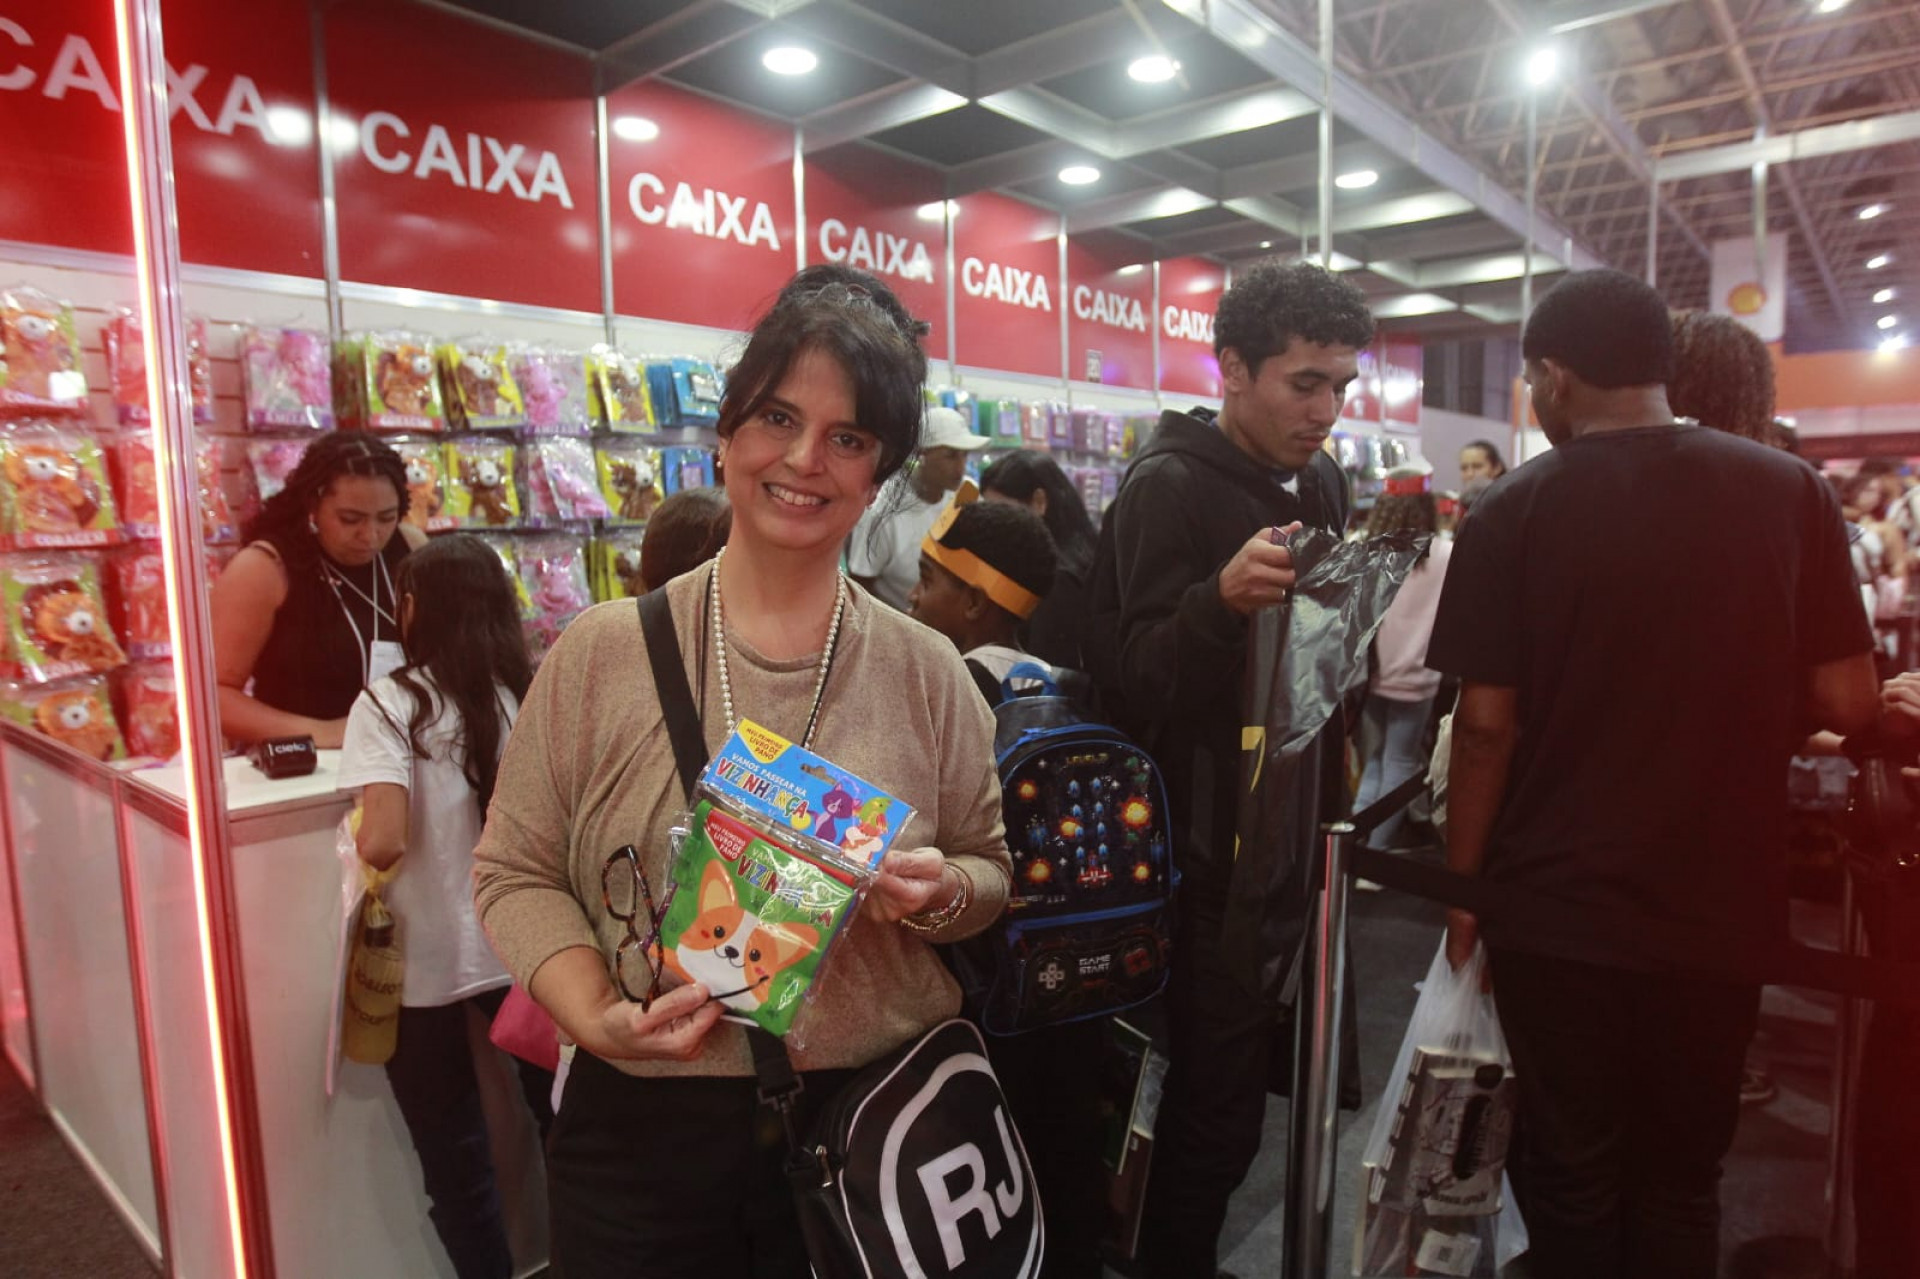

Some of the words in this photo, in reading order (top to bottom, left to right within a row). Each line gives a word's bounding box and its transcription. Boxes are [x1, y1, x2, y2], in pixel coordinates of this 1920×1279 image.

[0, 17, 280, 146] CAXA
[359, 110, 574, 210] CAIXA
[628, 172, 780, 251] CAIXA
[819, 218, 934, 284] CAIXA
[961, 257, 1052, 312] CAIXA
[1073, 284, 1146, 333] CAIXA
[274, 742, 306, 753] cielo
[749, 736, 770, 750] LIVRO
[769, 745, 779, 757] DE
[754, 747, 775, 760] PANO
[715, 757, 810, 818] VIZINHANÇA
[732, 753, 760, 771] VAMOS
[761, 769, 794, 790] PASSEAR
[794, 784, 808, 797] NA
[713, 832, 733, 848] LIVRO
[732, 842, 743, 854] DE
[719, 843, 738, 860] PANO
[1079, 954, 1112, 966] GAME
[1079, 963, 1112, 975] START
[916, 1104, 1024, 1272] RJ
